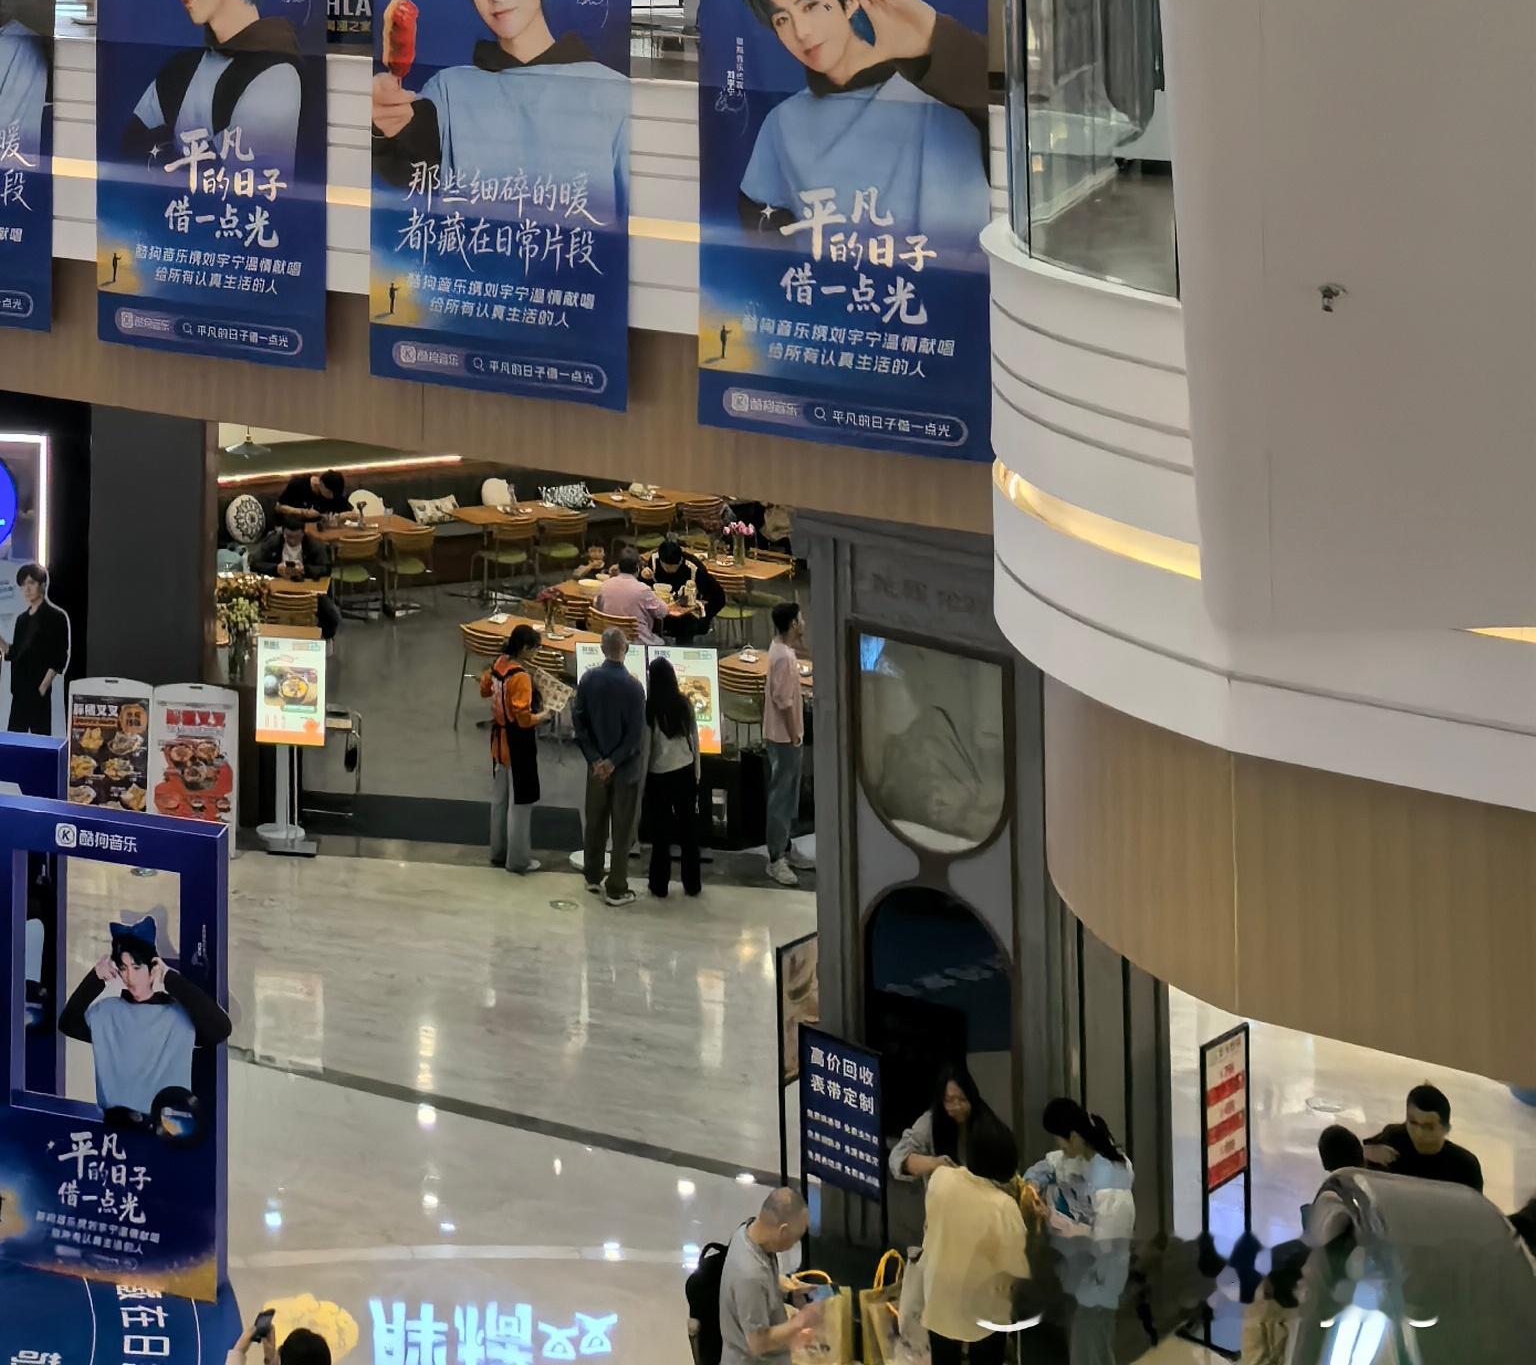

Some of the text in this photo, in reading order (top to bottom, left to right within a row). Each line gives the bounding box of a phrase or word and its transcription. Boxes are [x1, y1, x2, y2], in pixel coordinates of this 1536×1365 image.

[166, 126, 254, 191] 平凡
[202, 167, 287, 202] 的日子
[403, 161, 606, 226] 那些细碎的暖
[165, 199, 278, 247] 借一点光
[780, 187, 893, 261] 平凡
[135, 243, 301, 277] 酷狗音乐携刘宇宁温情献唱
[399, 210, 603, 276] 都藏在日常片段
[829, 233, 937, 271] 的日子
[155, 266, 278, 294] 给所有认真生活的人
[406, 273, 595, 309] 酷狗音乐携刘宇宁温情献唱
[782, 265, 928, 325] 借一点光
[430, 297, 570, 328] 给所有认真生活的人
[197, 323, 288, 347] 平凡的日子借一点光
[742, 314, 955, 357] 酷狗音乐携刘宇宁温情献唱
[489, 358, 594, 385] 平凡的日子借一点光
[768, 341, 926, 379] 给所有认真生活的人
[832, 410, 950, 437] 平凡的日子借一点光
[80, 830, 137, 853] 酷狗音乐
[810, 1046, 874, 1088] 高价回收
[810, 1074, 874, 1115] 表带定制
[59, 1131, 126, 1179] 平凡
[88, 1163, 151, 1190] 的日子
[59, 1181, 145, 1223] 借一点光
